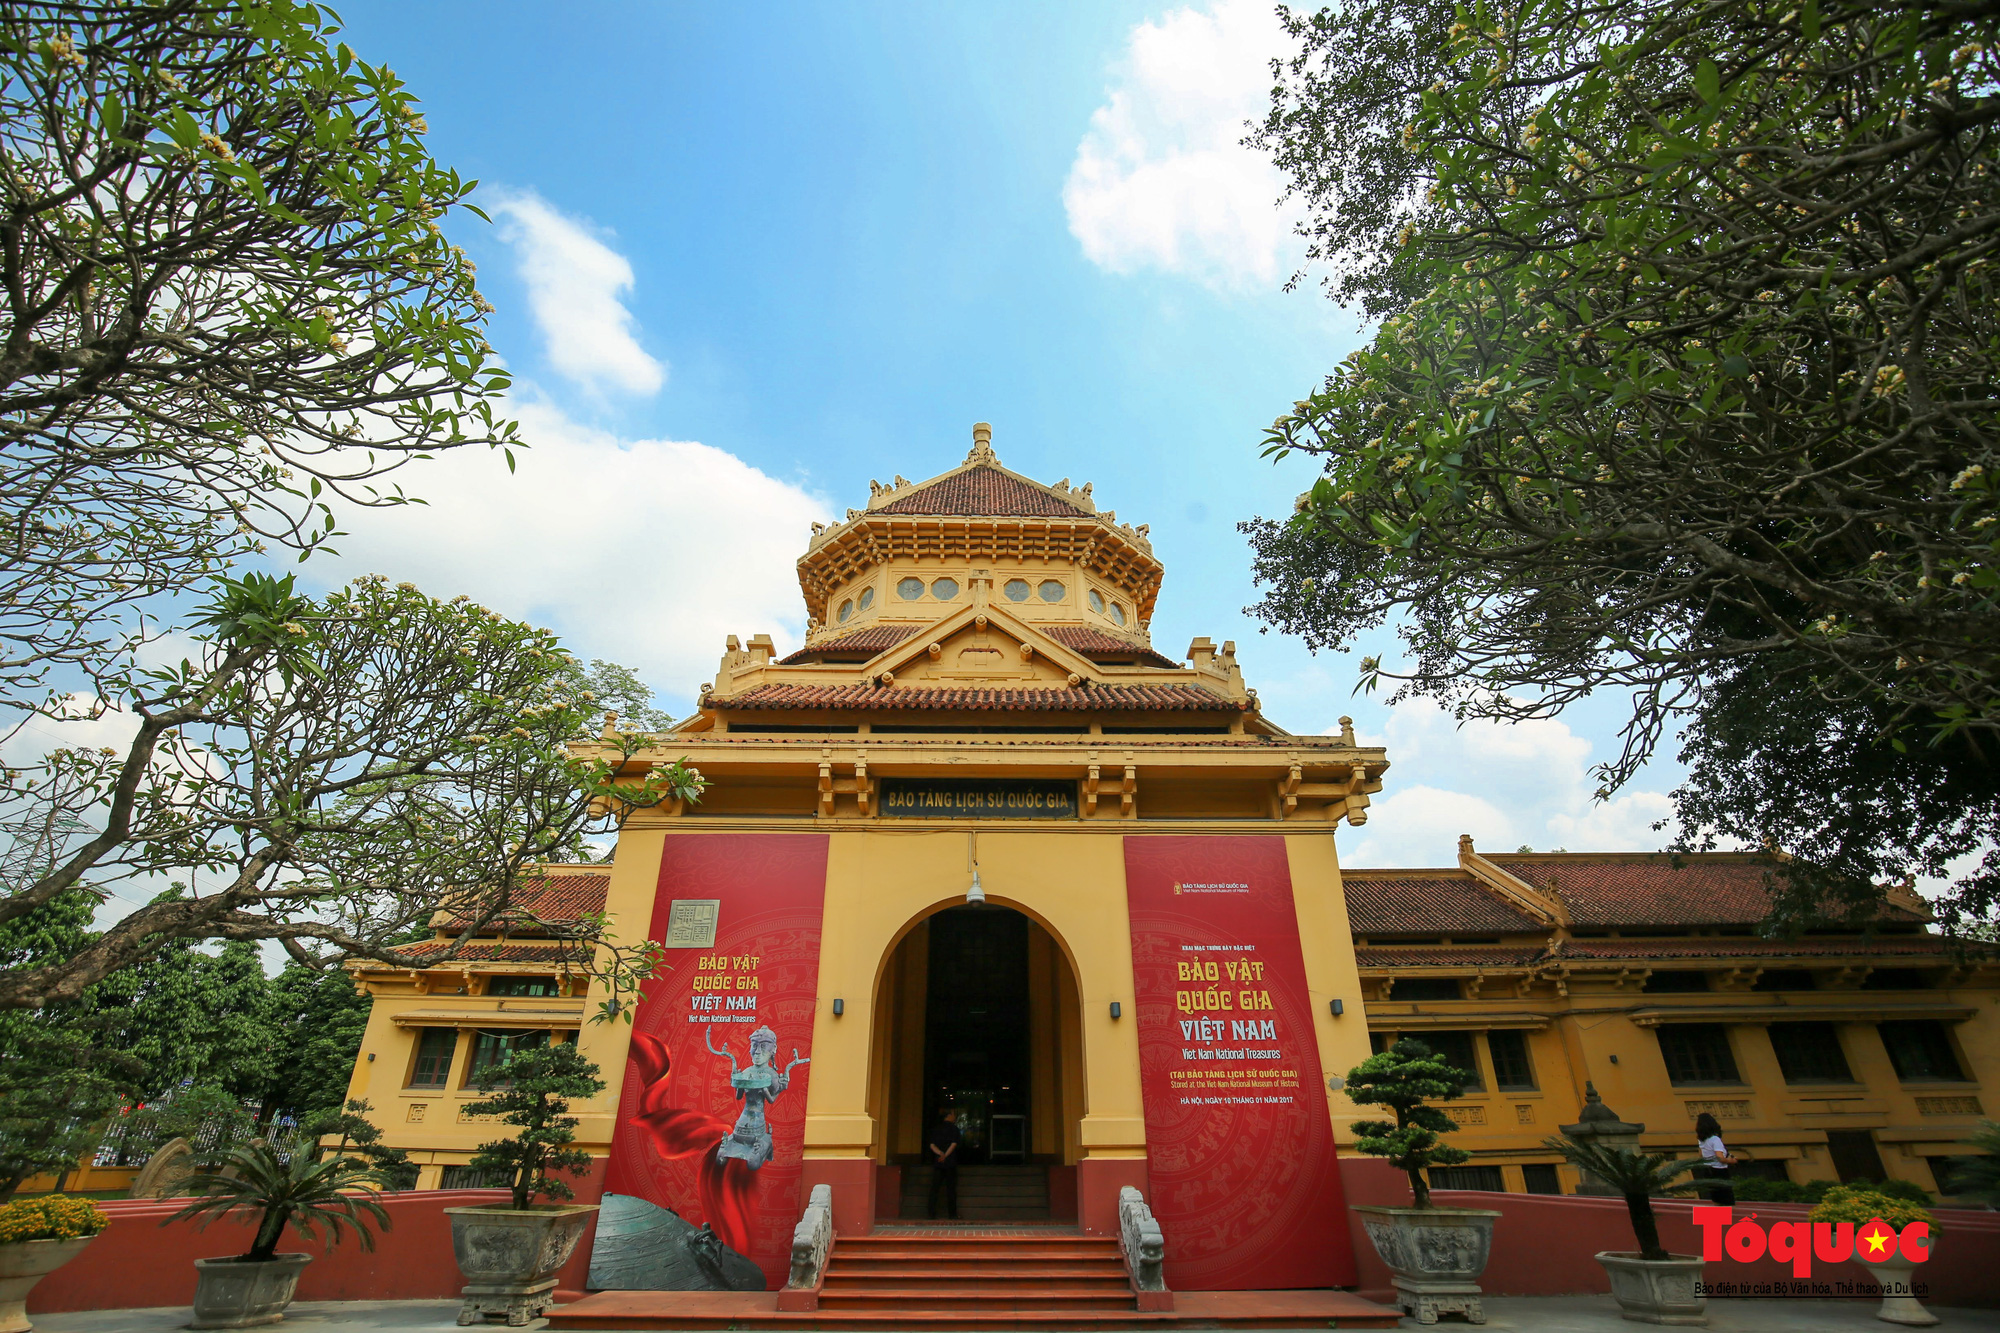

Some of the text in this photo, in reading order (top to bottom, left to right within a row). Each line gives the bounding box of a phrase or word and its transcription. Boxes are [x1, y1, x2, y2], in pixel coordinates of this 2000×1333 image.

[889, 786, 1069, 812] BẢO TÀNG LỊCH SỬ QUỐC GIA
[698, 952, 760, 974] BẢO VẬT
[1177, 956, 1264, 986] BẢO VẬT
[692, 971, 759, 993] QUỐC GIA
[691, 993, 757, 1013] VIỆT NAM
[1176, 983, 1274, 1015] QUỐC GIA
[688, 1014, 757, 1023] Viet Nam National Treasures
[1179, 1015, 1278, 1046] VIỆT NAM
[1182, 1048, 1281, 1060] Viet Nam National Treasures
[1170, 1068, 1298, 1080] (TẠI BẢO TÀNG LỊCH SỬ QUỐC GIA)
[1170, 1079, 1300, 1089] Stored at the Viet Nam National Museum of History
[1180, 1096, 1191, 1105] HÀ
[1205, 1096, 1223, 1104] NGÀY
[1232, 1096, 1255, 1104] THÁNG
[1264, 1096, 1279, 1104] NĂM
[1279, 1096, 1294, 1104] 2017
